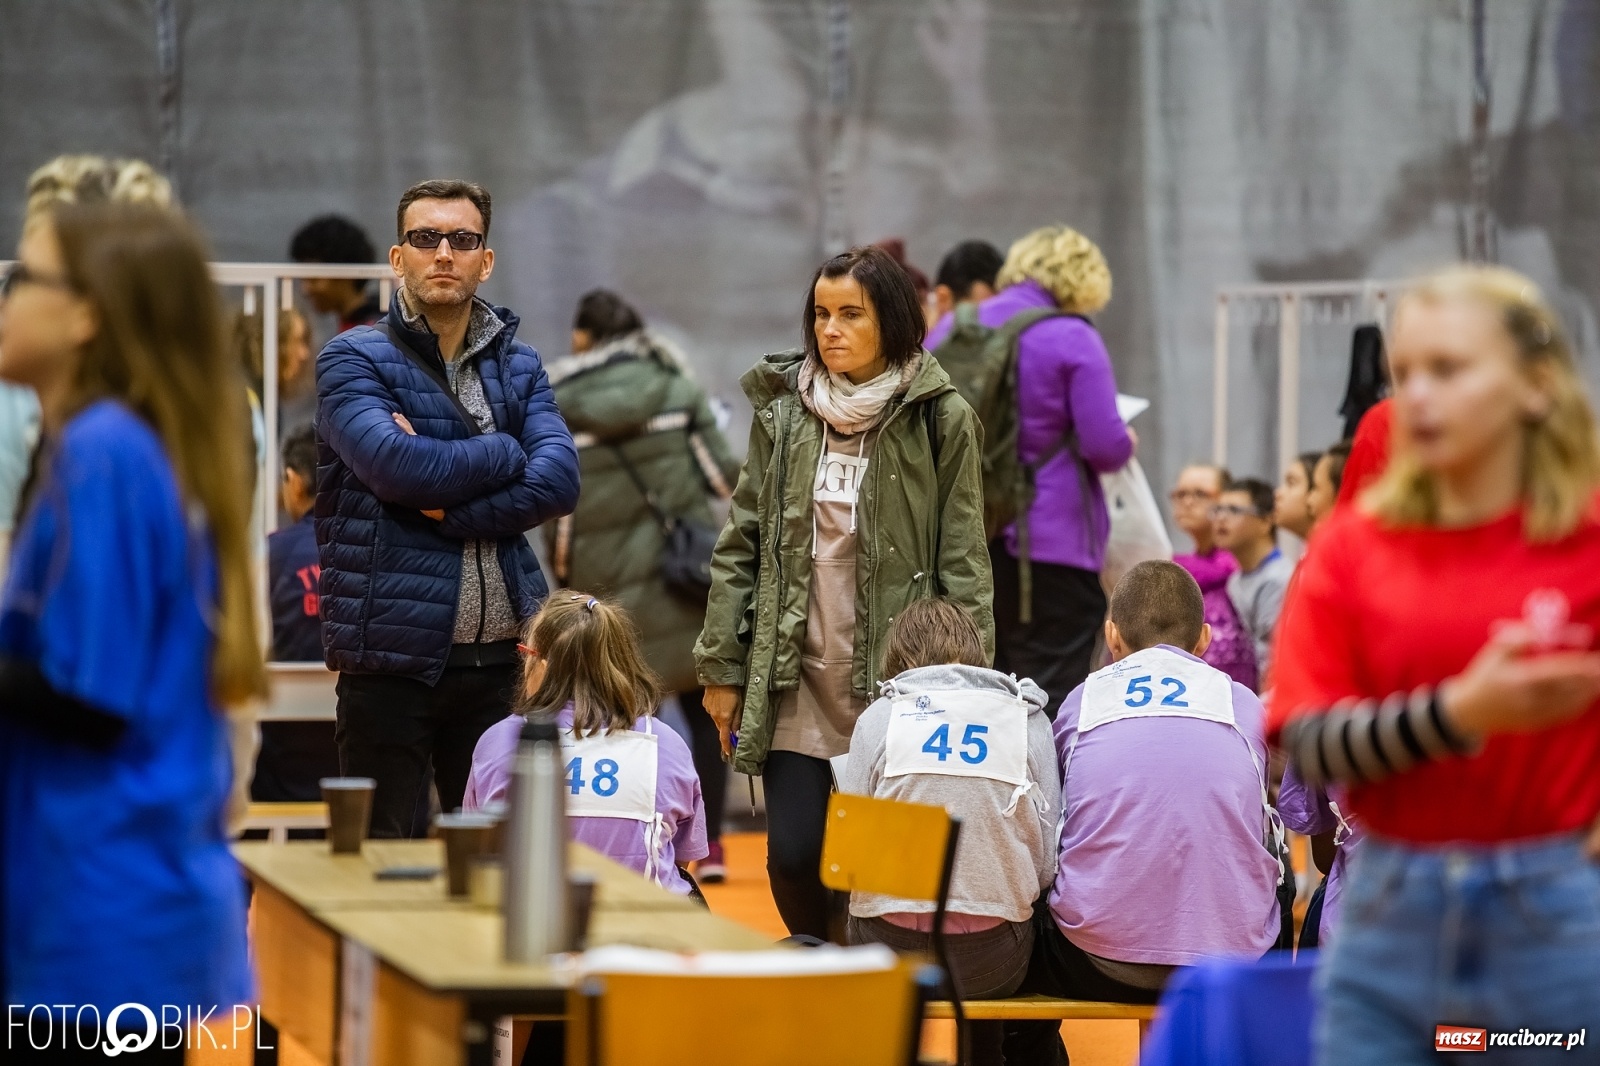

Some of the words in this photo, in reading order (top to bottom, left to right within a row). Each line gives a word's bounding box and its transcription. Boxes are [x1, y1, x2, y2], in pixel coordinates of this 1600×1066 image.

[1124, 675, 1189, 708] 52
[921, 723, 989, 765] 45
[563, 756, 619, 797] 48
